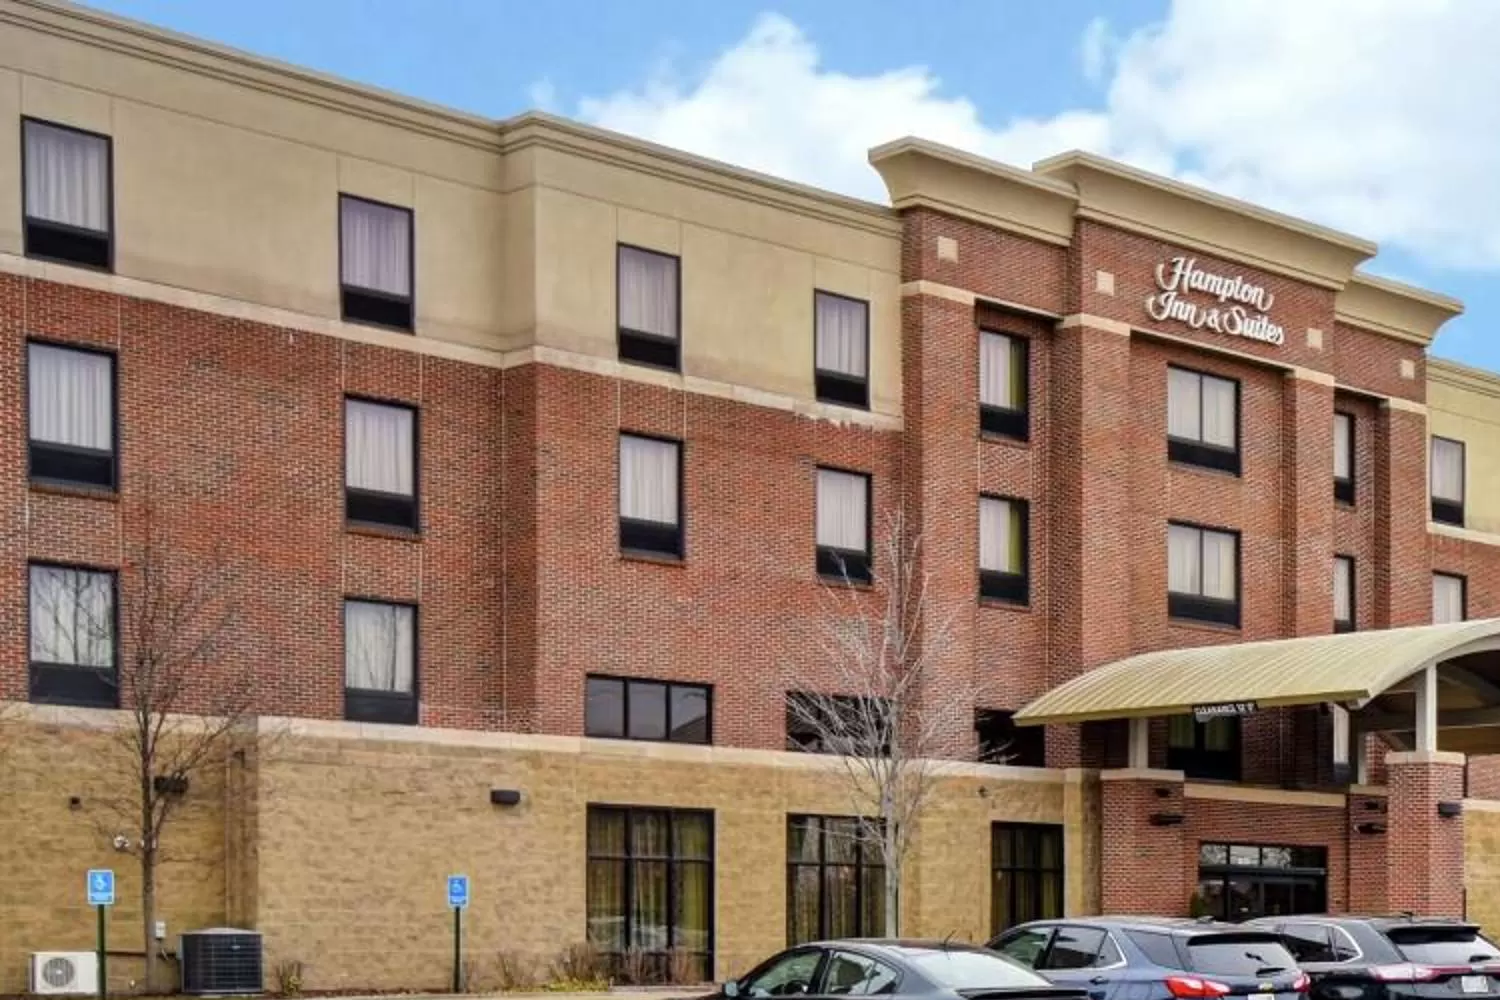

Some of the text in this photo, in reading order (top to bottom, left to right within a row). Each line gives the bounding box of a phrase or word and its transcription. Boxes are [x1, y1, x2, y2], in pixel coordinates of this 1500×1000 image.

[1156, 257, 1274, 311] Hampton
[1146, 292, 1284, 345] Inn & Suites
